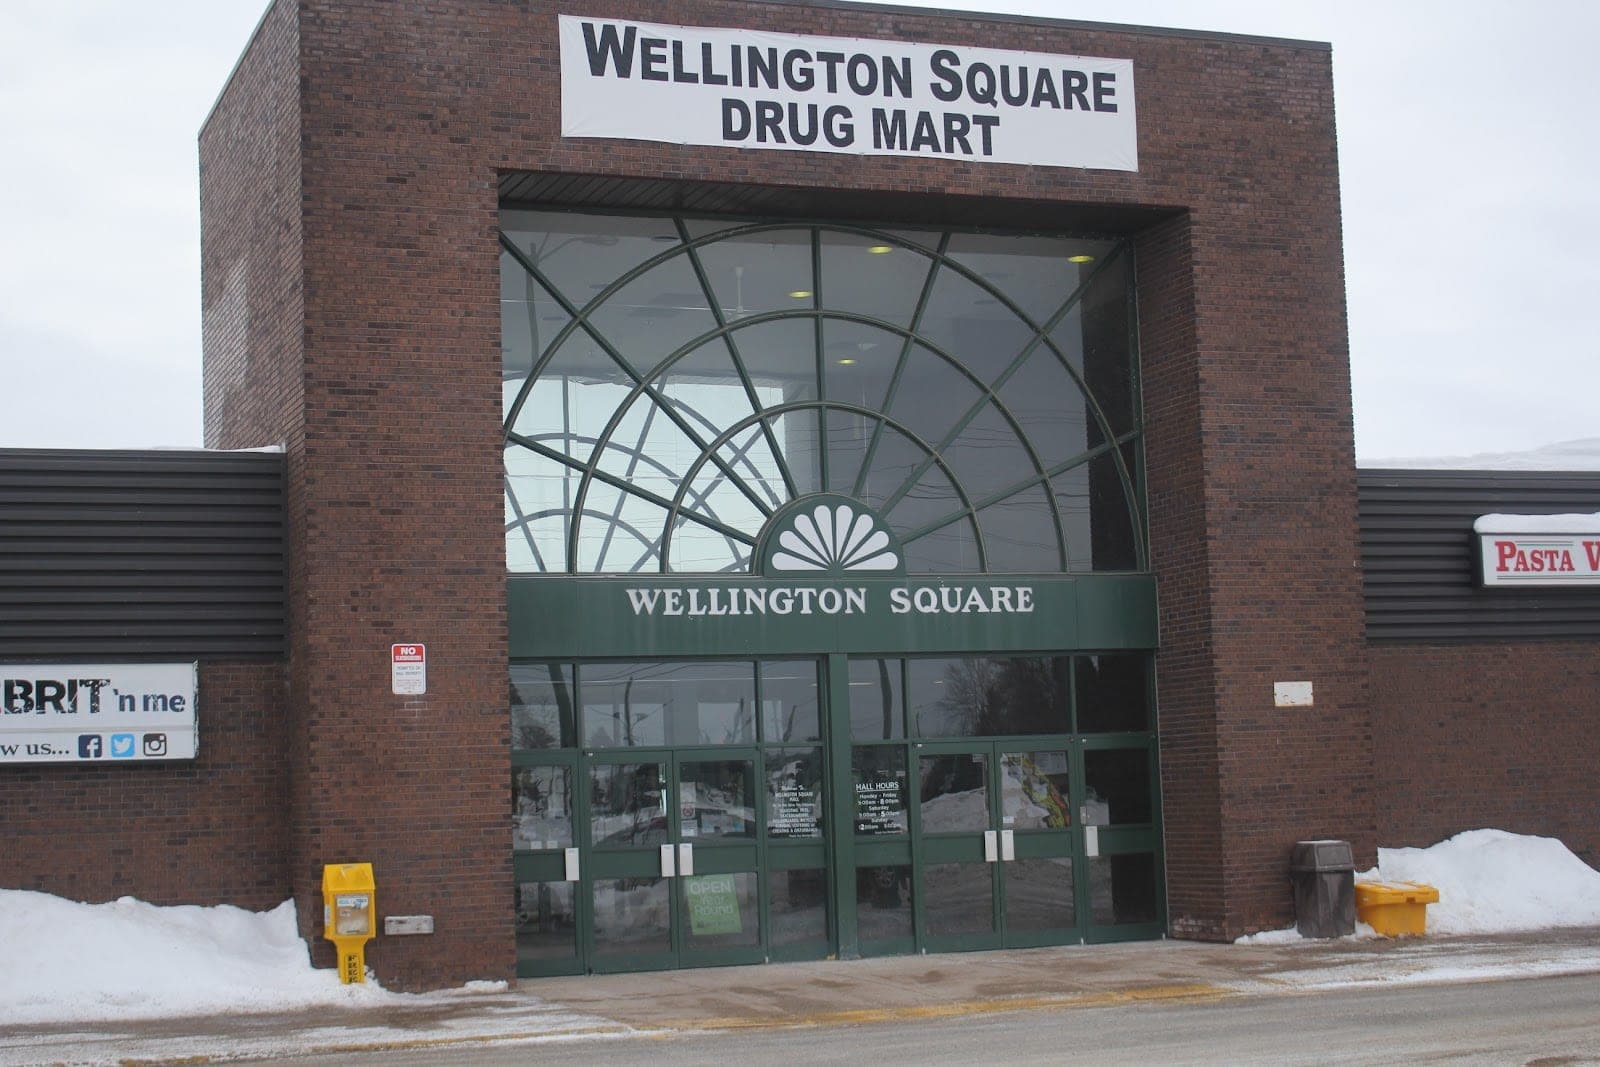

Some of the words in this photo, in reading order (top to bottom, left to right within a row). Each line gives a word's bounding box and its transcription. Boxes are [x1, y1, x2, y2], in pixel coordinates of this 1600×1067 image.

[581, 22, 912, 98] WELLINGTON
[929, 49, 1118, 113] SQUARE
[721, 98, 855, 148] DRUG
[872, 107, 1000, 156] MART
[1494, 541, 1576, 572] PASTA
[626, 588, 867, 616] WELLINGTON
[889, 586, 1035, 613] SQUARE
[400, 647, 416, 655] NO
[143, 693, 186, 713] me
[876, 782, 899, 790] HOURS
[690, 880, 732, 895] OPEN
